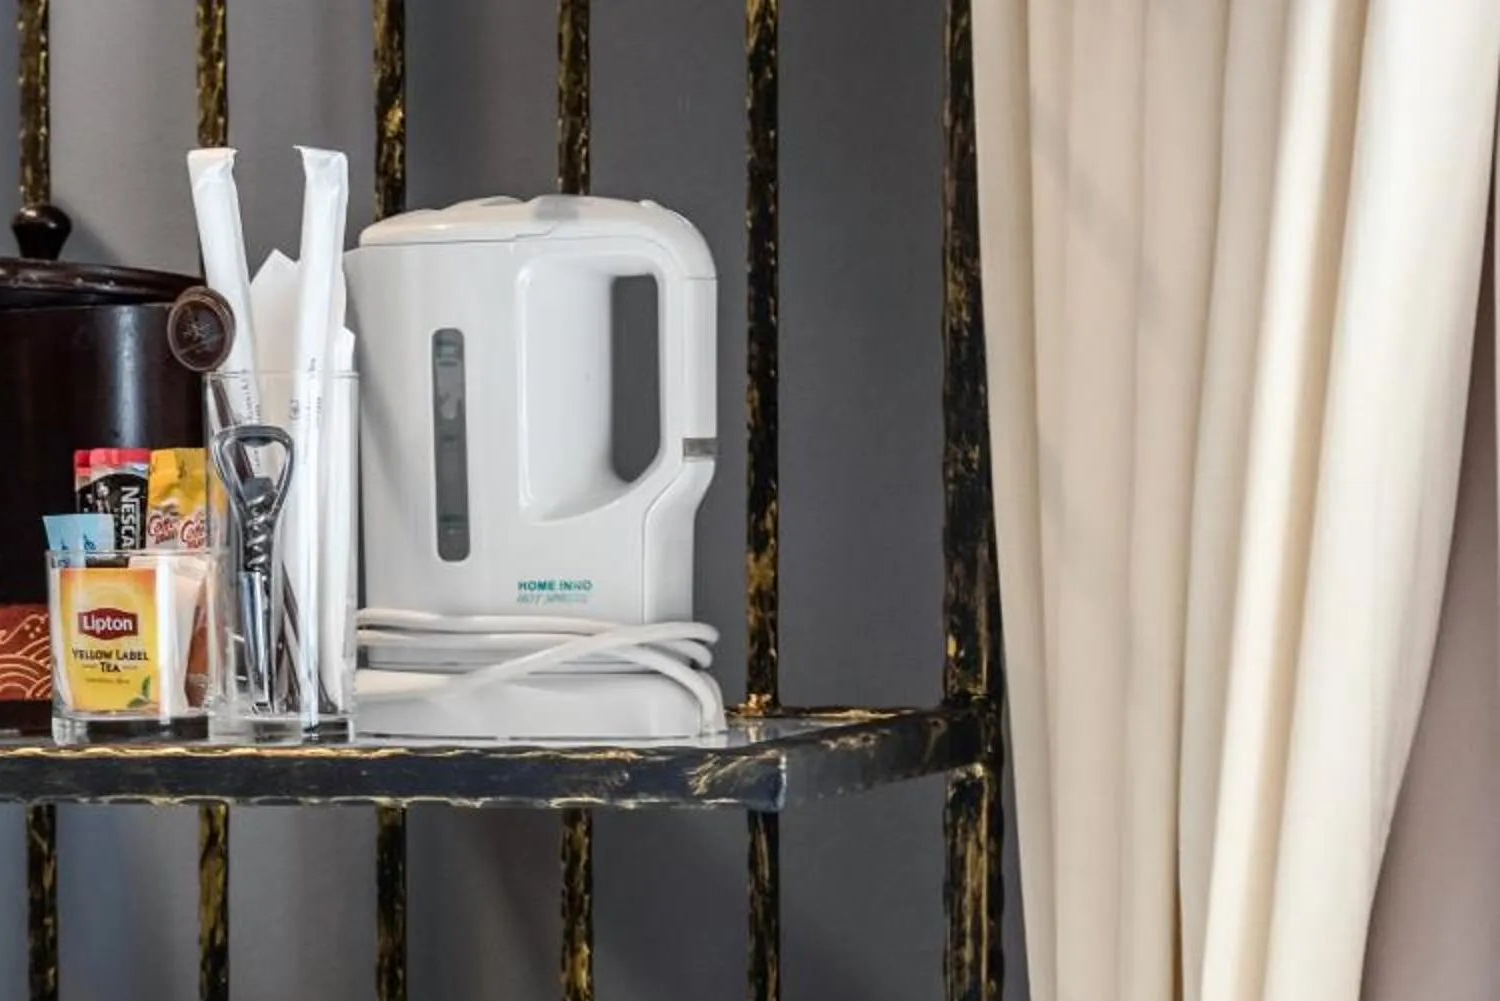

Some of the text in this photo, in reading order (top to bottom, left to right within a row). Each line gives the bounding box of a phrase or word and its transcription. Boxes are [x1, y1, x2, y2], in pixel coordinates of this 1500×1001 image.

[121, 486, 139, 550] NESCA
[517, 581, 555, 591] HOME
[83, 615, 133, 635] Lipton
[72, 648, 148, 661] YELLOW LABEL
[100, 661, 120, 673] TEA
